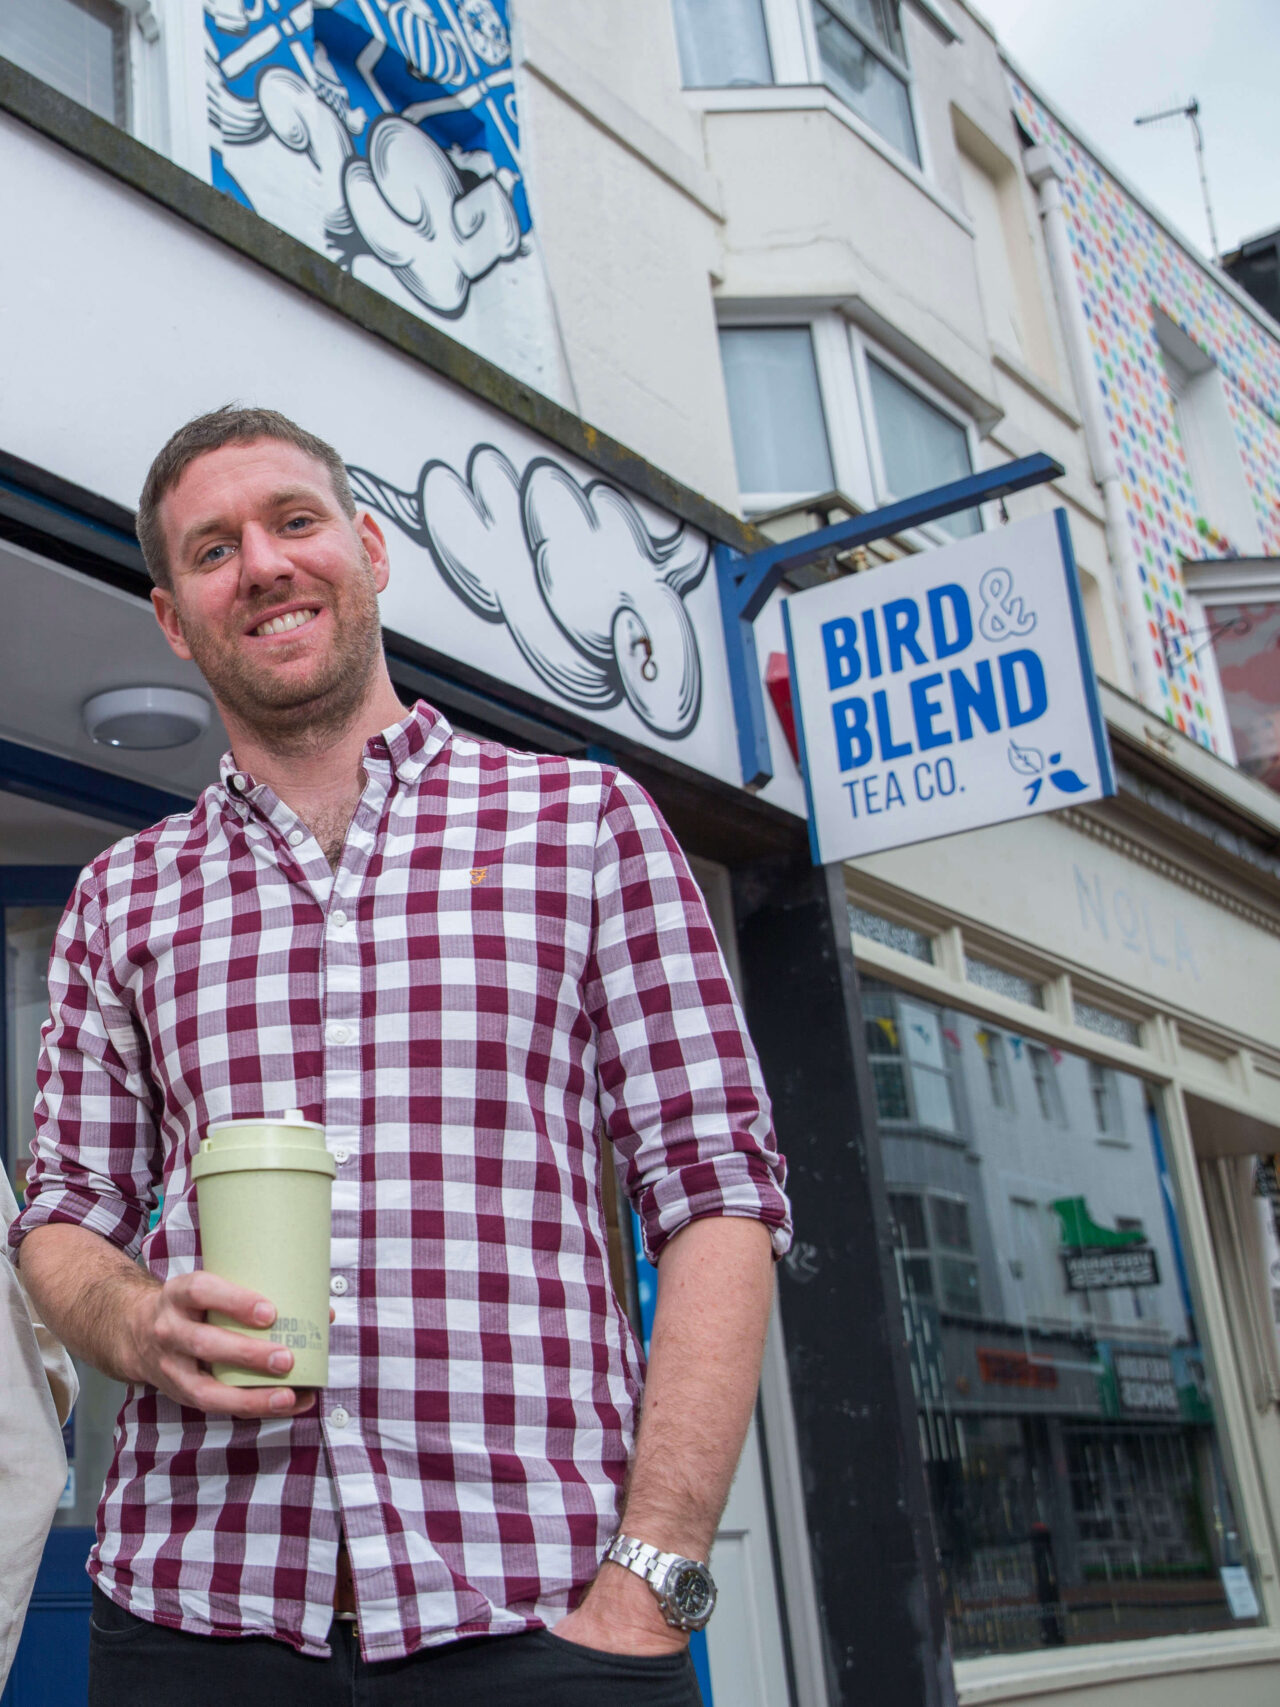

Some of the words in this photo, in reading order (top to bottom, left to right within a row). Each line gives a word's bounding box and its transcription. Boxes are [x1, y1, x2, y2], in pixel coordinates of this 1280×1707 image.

[820, 583, 973, 692] BIRD
[979, 567, 1037, 643] &
[831, 648, 1048, 773] BLEND
[842, 771, 907, 819] TEA
[913, 757, 966, 802] CO.
